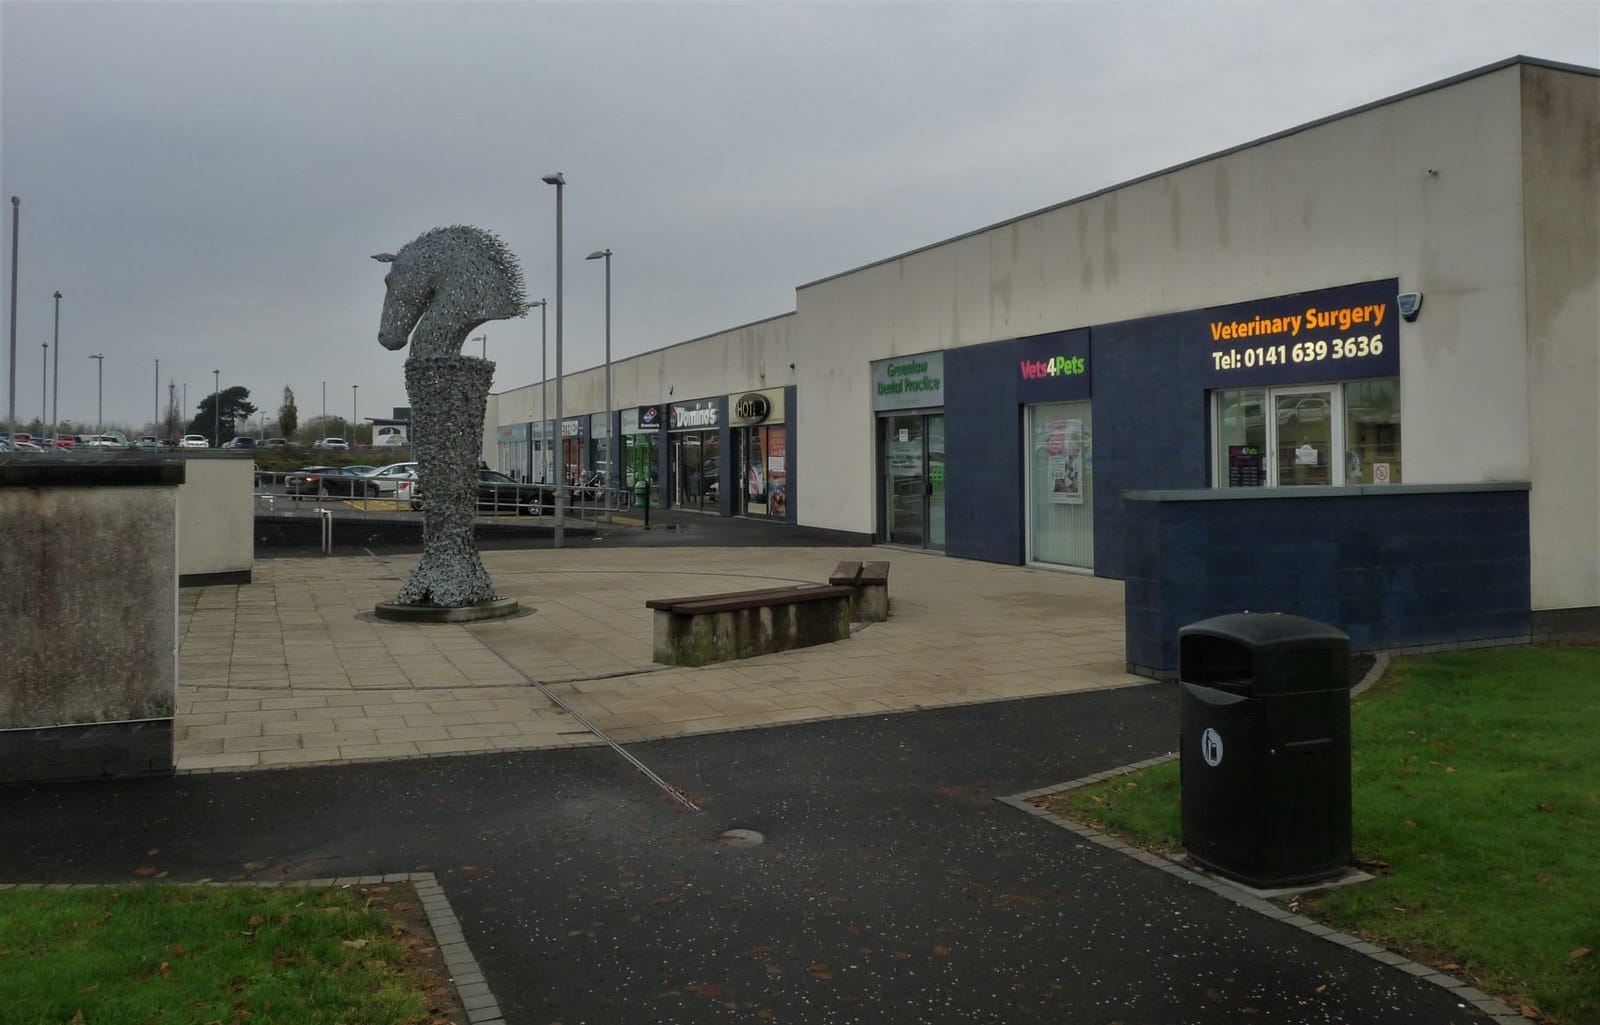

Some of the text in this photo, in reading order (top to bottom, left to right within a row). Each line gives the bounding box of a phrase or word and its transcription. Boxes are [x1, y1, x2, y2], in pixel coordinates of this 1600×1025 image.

[1210, 303, 1387, 342] Veterinary Surgery
[1212, 334, 1385, 371] Tel: 0141 639 3636
[1020, 355, 1085, 380] Vets4Pets
[877, 375, 940, 396] Dental Practice
[676, 401, 718, 428] Domino's
